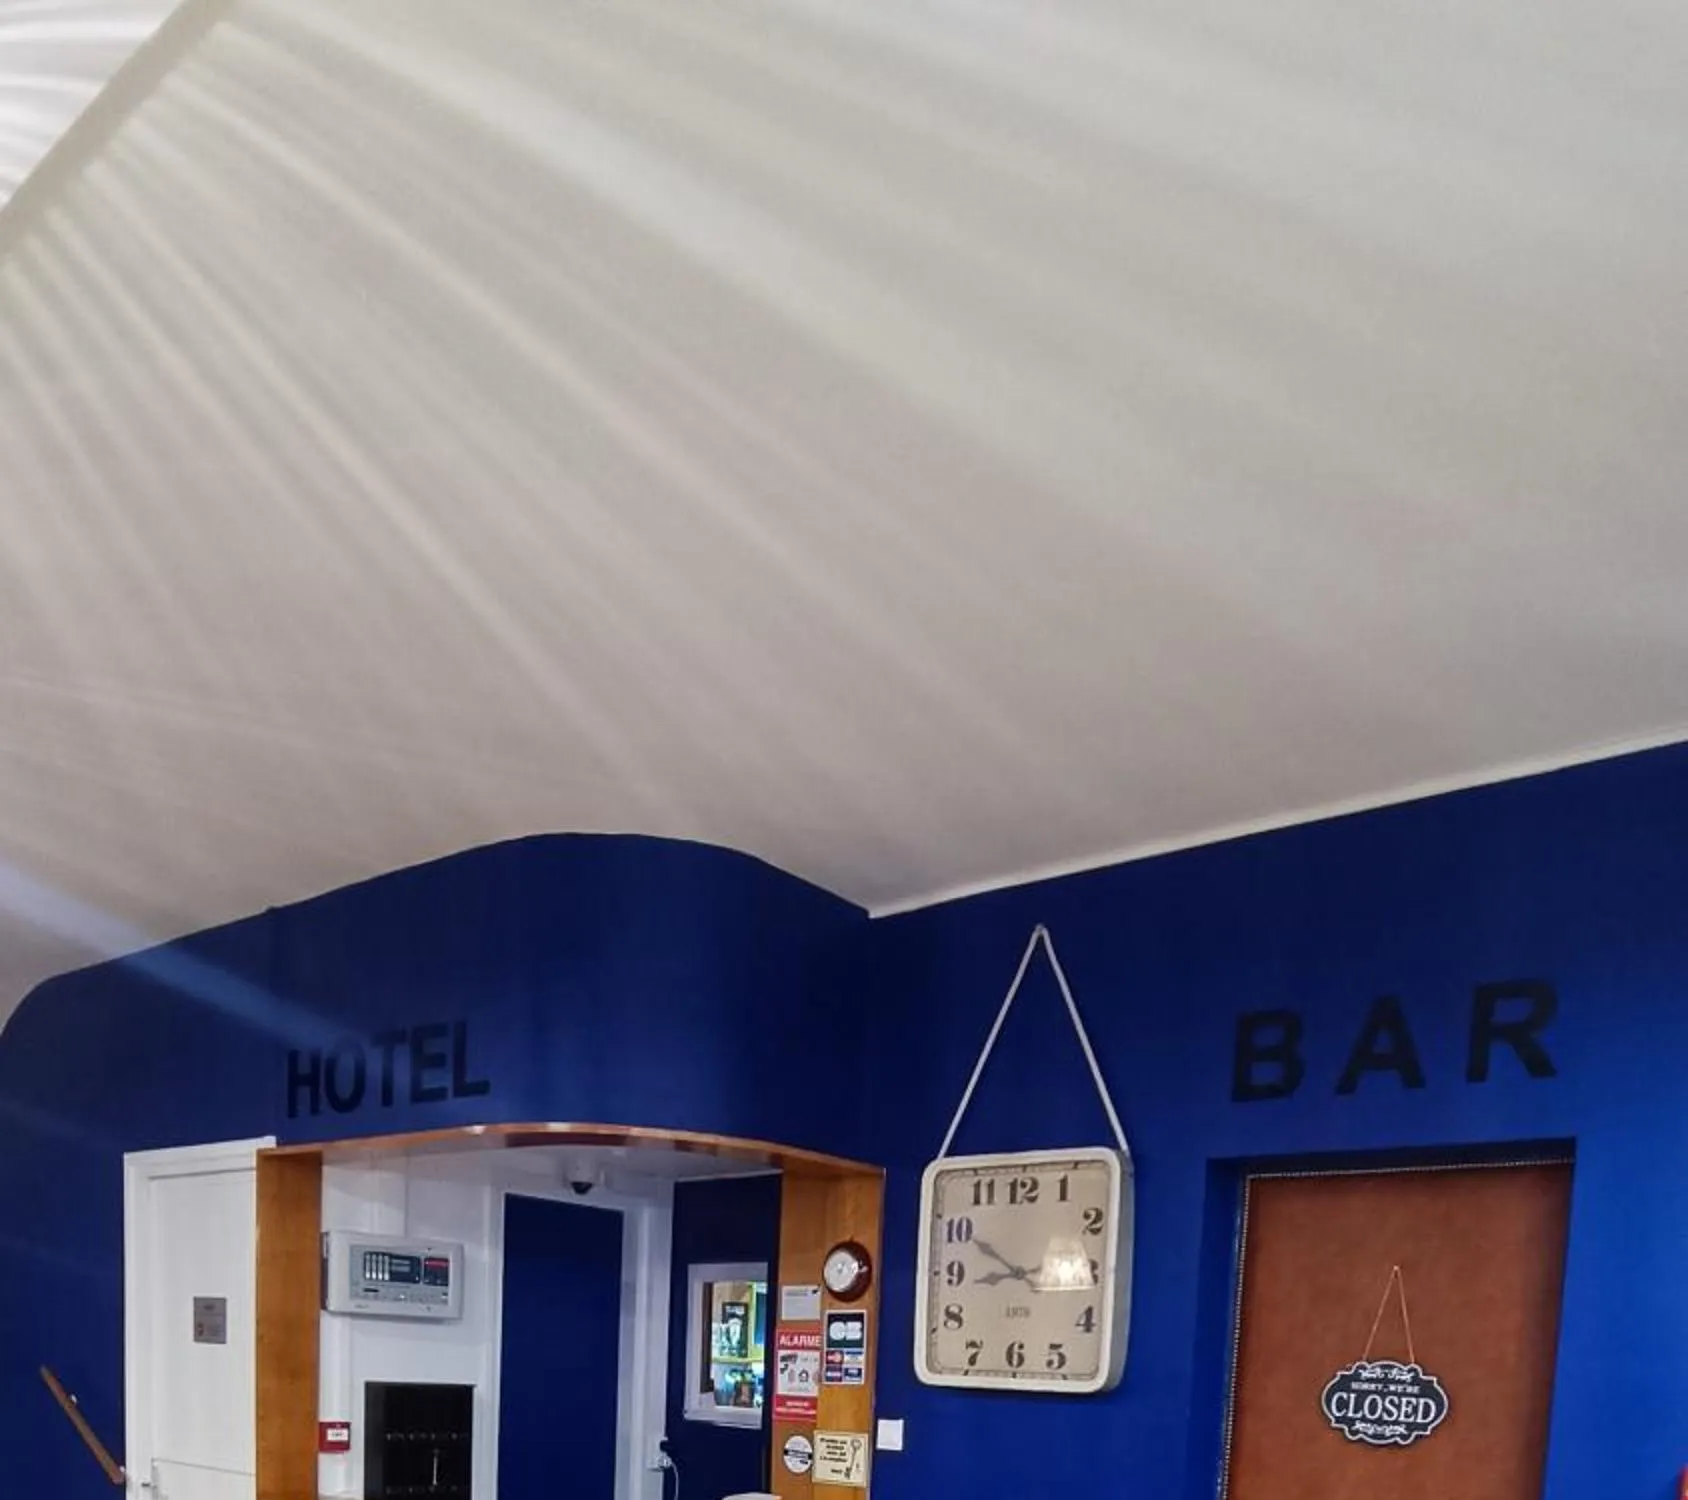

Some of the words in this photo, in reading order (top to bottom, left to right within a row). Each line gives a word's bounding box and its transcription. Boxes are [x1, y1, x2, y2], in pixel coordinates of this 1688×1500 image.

[1231, 977, 1558, 1102] BAR
[287, 1021, 490, 1118] HOTEL
[972, 1178, 995, 1206] 11
[1008, 1176, 1039, 1205] 12
[1057, 1174, 1070, 1202] 1
[946, 1216, 973, 1243] 10
[1082, 1207, 1104, 1235] 2
[946, 1260, 965, 1287] 9
[943, 1303, 963, 1331] 8
[1075, 1305, 1096, 1333] 4
[780, 1334, 821, 1347] ALARME
[965, 1339, 984, 1367] 7
[1006, 1341, 1025, 1369] 6
[1046, 1343, 1067, 1370] 5
[1331, 1392, 1437, 1423] CLOSED
